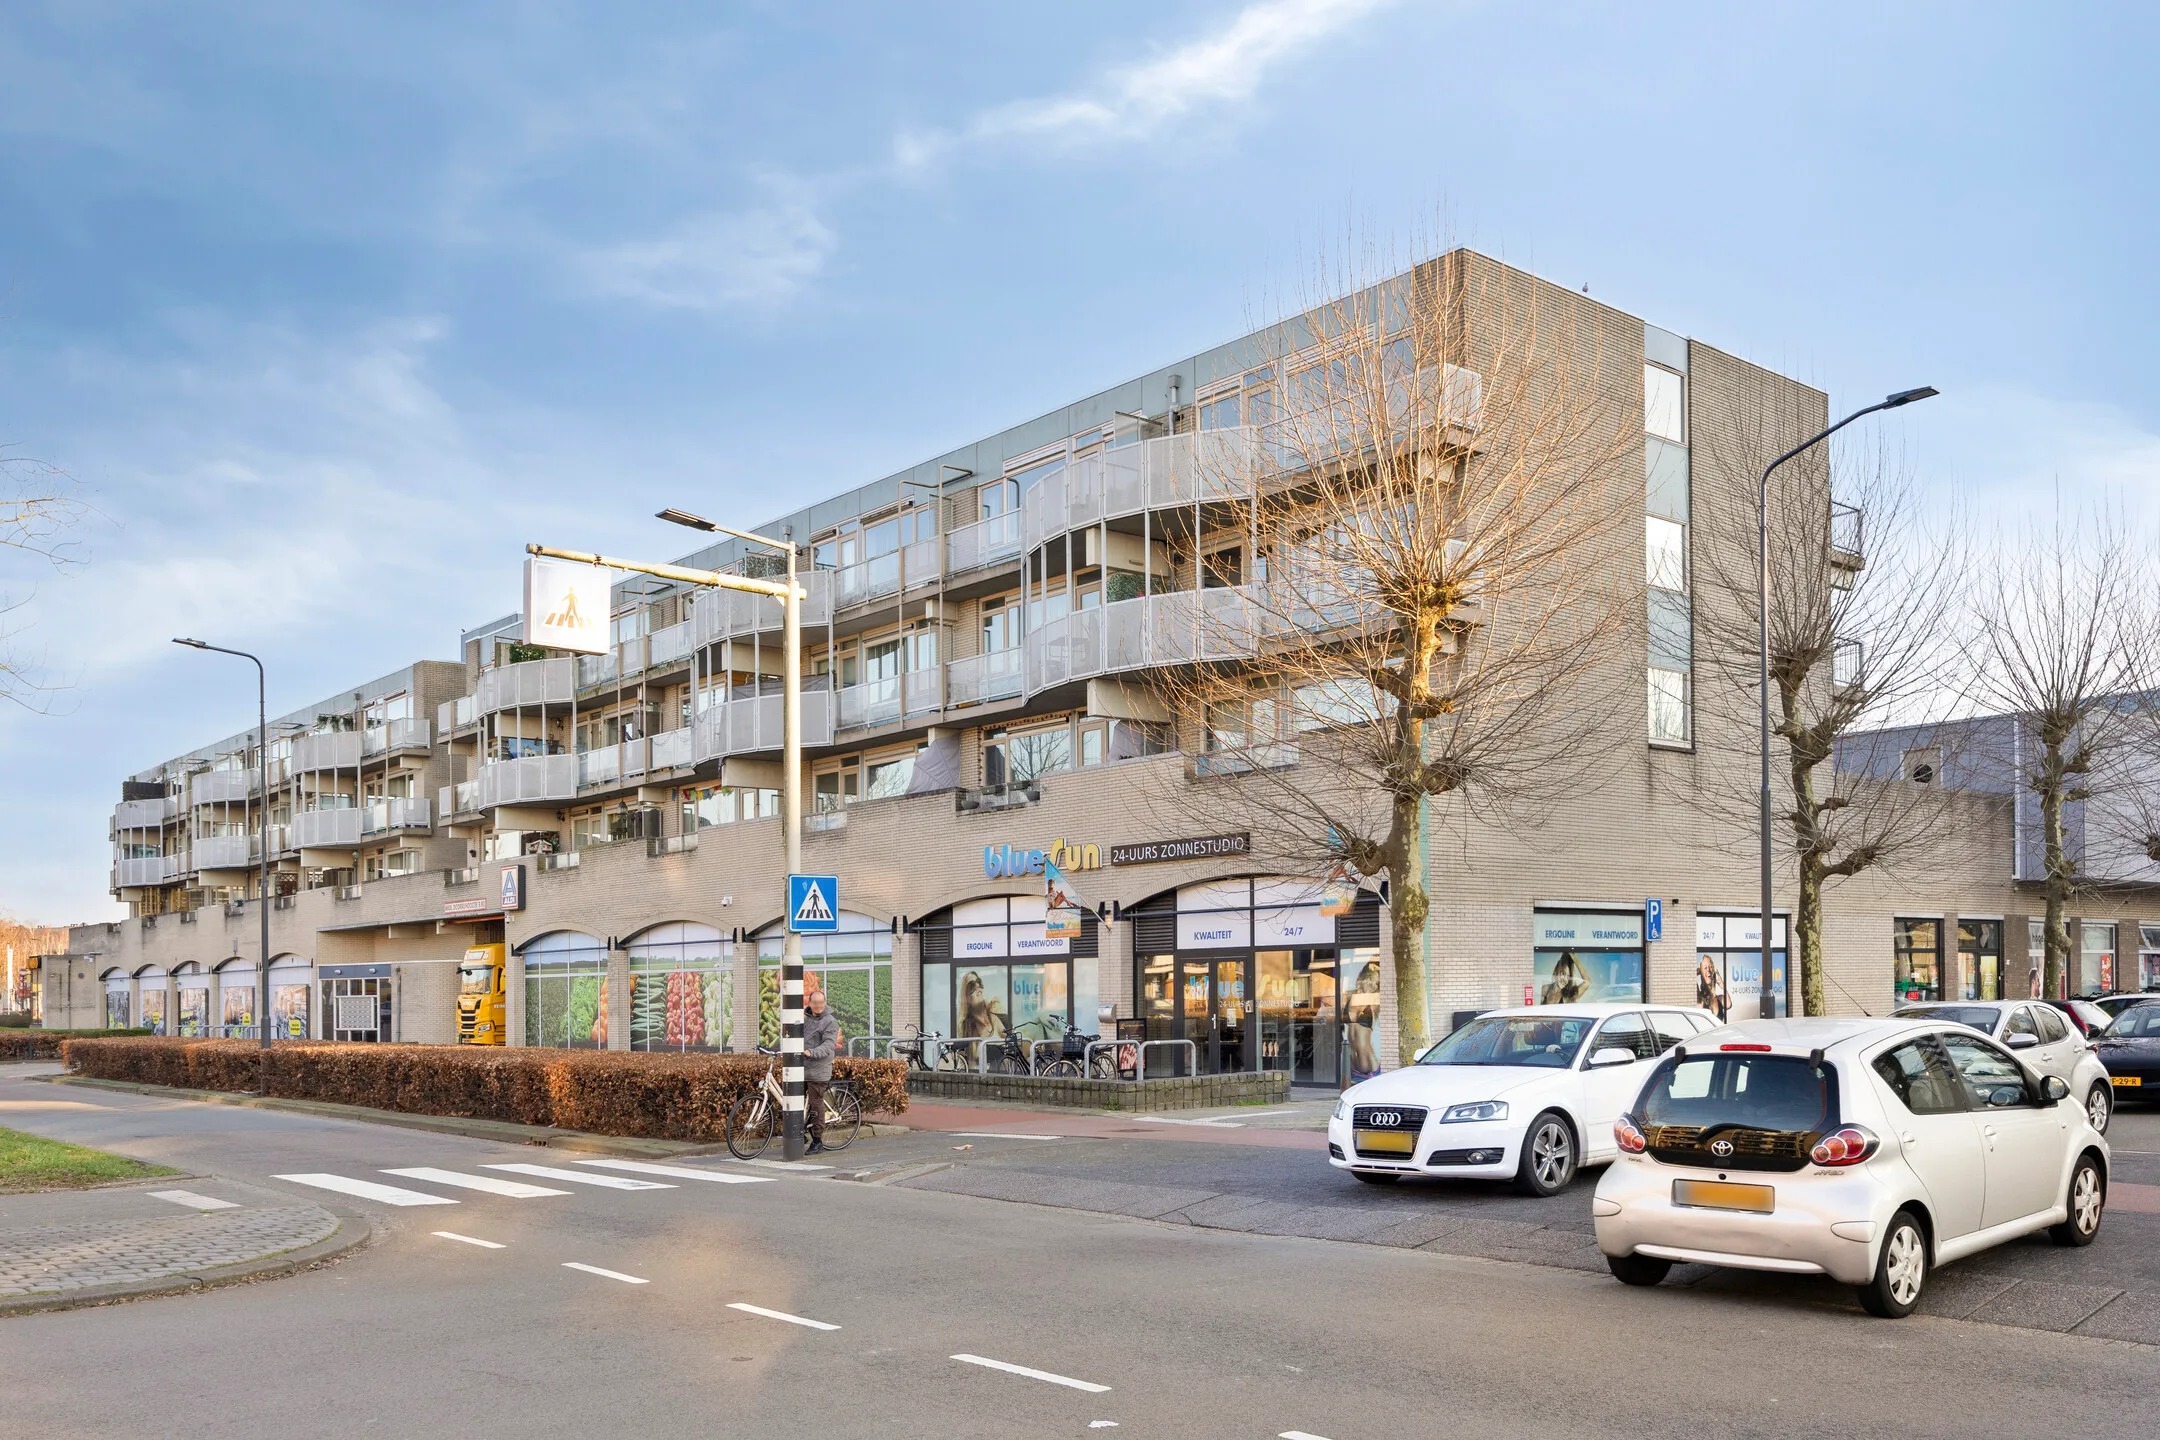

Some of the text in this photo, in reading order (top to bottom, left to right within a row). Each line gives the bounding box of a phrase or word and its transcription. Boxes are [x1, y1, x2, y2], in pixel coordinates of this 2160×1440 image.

[1112, 837, 1244, 863] 24-UURS ZONNESTUDIO
[984, 844, 1045, 879] blue
[1650, 901, 1659, 923] P
[1193, 930, 1232, 940] KWALITEIT
[1284, 927, 1303, 936] 24/7
[1545, 929, 1575, 939] ERGOLINE
[1592, 930, 1638, 940] VERANTWOORD
[1703, 932, 1715, 940] 24/7
[966, 942, 993, 951] ERGOLINE
[1017, 938, 1063, 949] VERANTWOORD
[1731, 964, 1760, 982] blue
